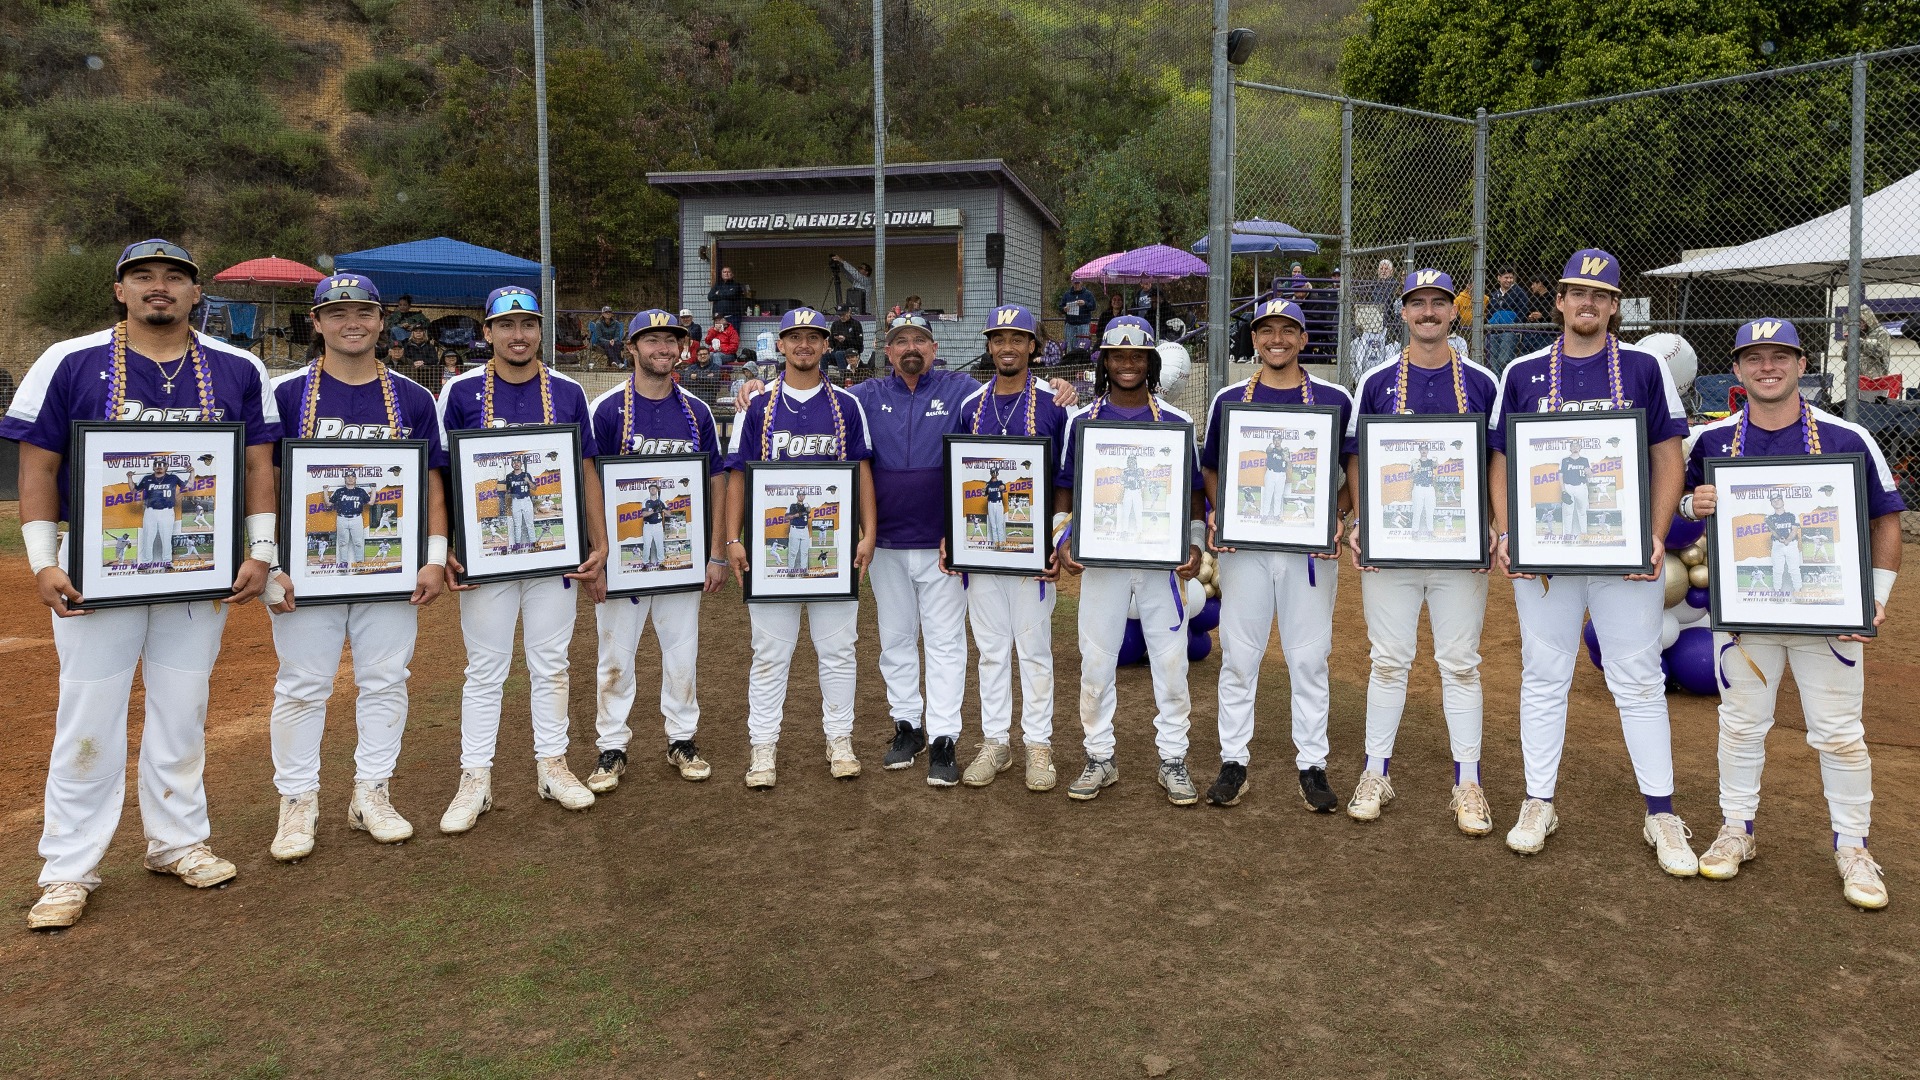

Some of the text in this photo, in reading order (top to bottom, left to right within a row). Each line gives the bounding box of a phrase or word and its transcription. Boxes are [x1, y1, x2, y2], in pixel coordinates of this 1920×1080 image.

[726, 211, 933, 229] HUGH B. MENDEZ SADIUM
[1580, 256, 1608, 276] W
[1416, 270, 1441, 286] W
[1266, 299, 1290, 314] W
[650, 312, 671, 327] W
[794, 310, 816, 326] W
[997, 309, 1020, 326] W
[1751, 321, 1783, 341] W
[123, 401, 224, 421] POET
[931, 399, 944, 410] WC
[772, 430, 839, 460] POETS
[1533, 438, 1602, 452] WHITIER
[103, 455, 192, 469] WHITIER
[1290, 451, 1316, 463] 2025
[1437, 460, 1464, 475] 2025
[1591, 460, 1622, 475] 2025
[148, 483, 170, 491] POETS
[535, 472, 561, 487] 2025
[1009, 481, 1033, 492] 2025
[163, 490, 172, 498] 10
[1734, 486, 1813, 500] WHITTIER
[667, 498, 691, 511] 2025
[813, 505, 838, 519] 2025
[1802, 510, 1838, 526] 2025
[1558, 533, 1578, 541] RILEY
